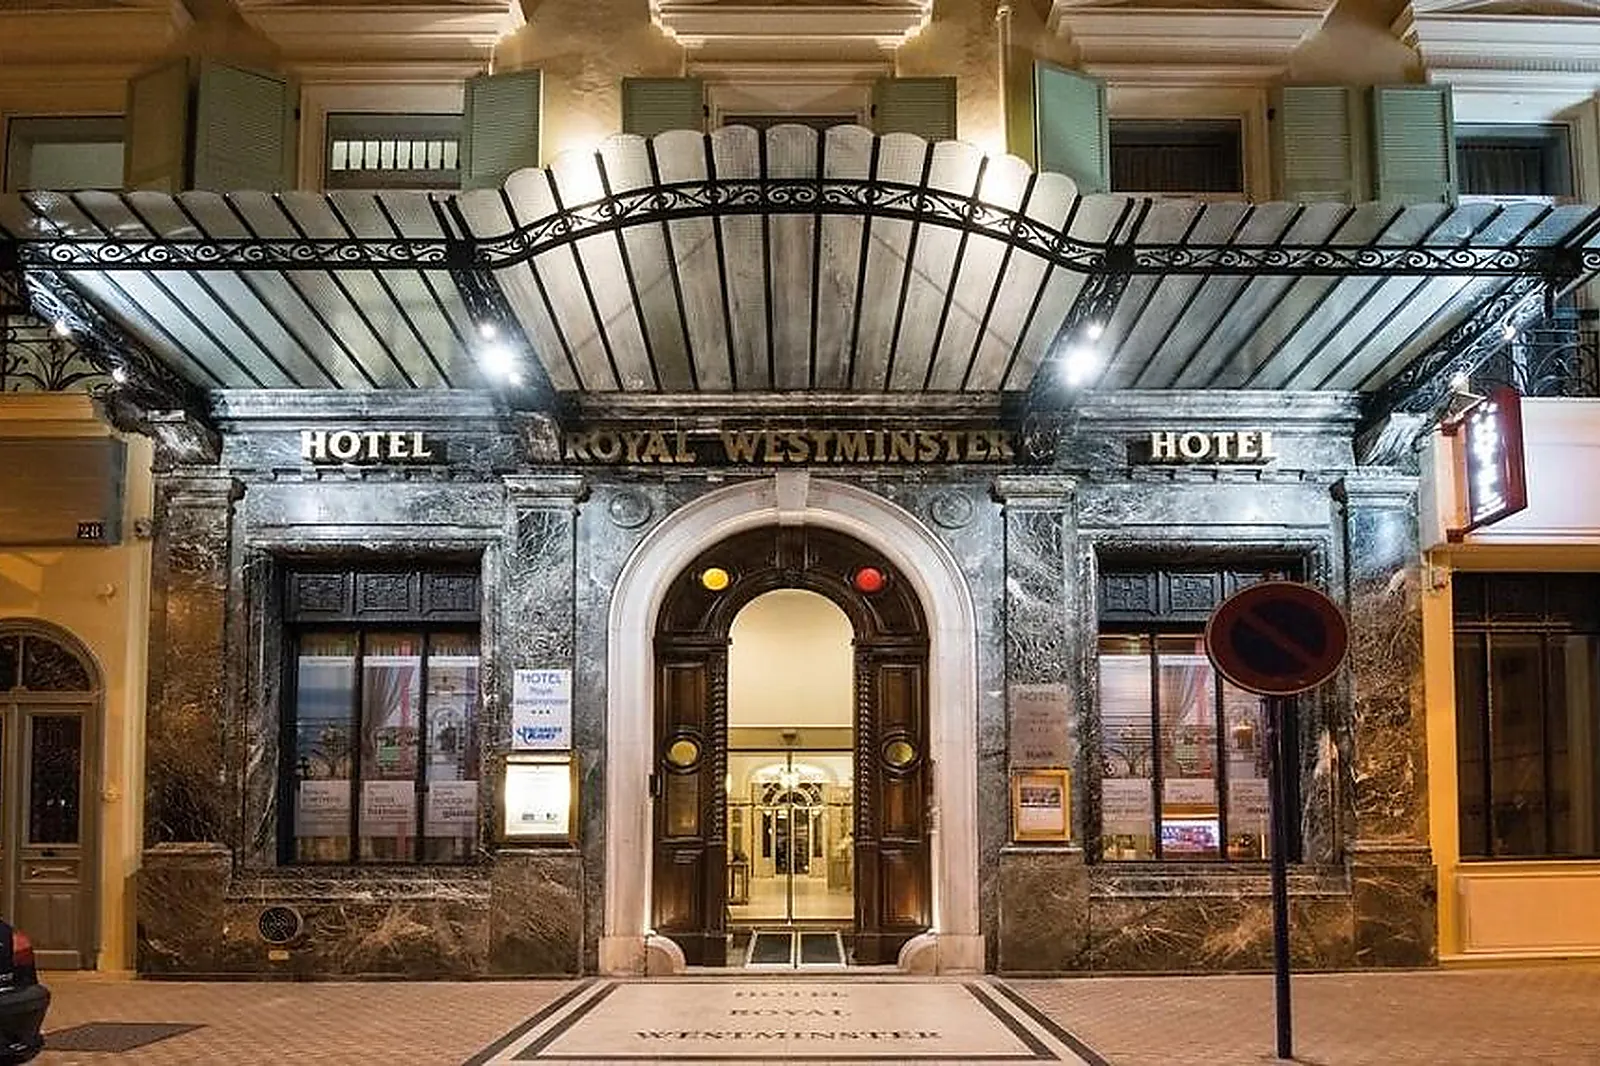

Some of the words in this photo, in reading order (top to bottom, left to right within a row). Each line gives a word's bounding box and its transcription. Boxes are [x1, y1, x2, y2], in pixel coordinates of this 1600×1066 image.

[300, 430, 431, 458] HOTEL
[564, 431, 697, 463] ROYAL
[719, 430, 1014, 463] WESTMINSTER
[1151, 431, 1279, 458] HOTEL
[521, 672, 562, 684] HOTEL
[634, 1030, 943, 1040] WESTMINSTER
